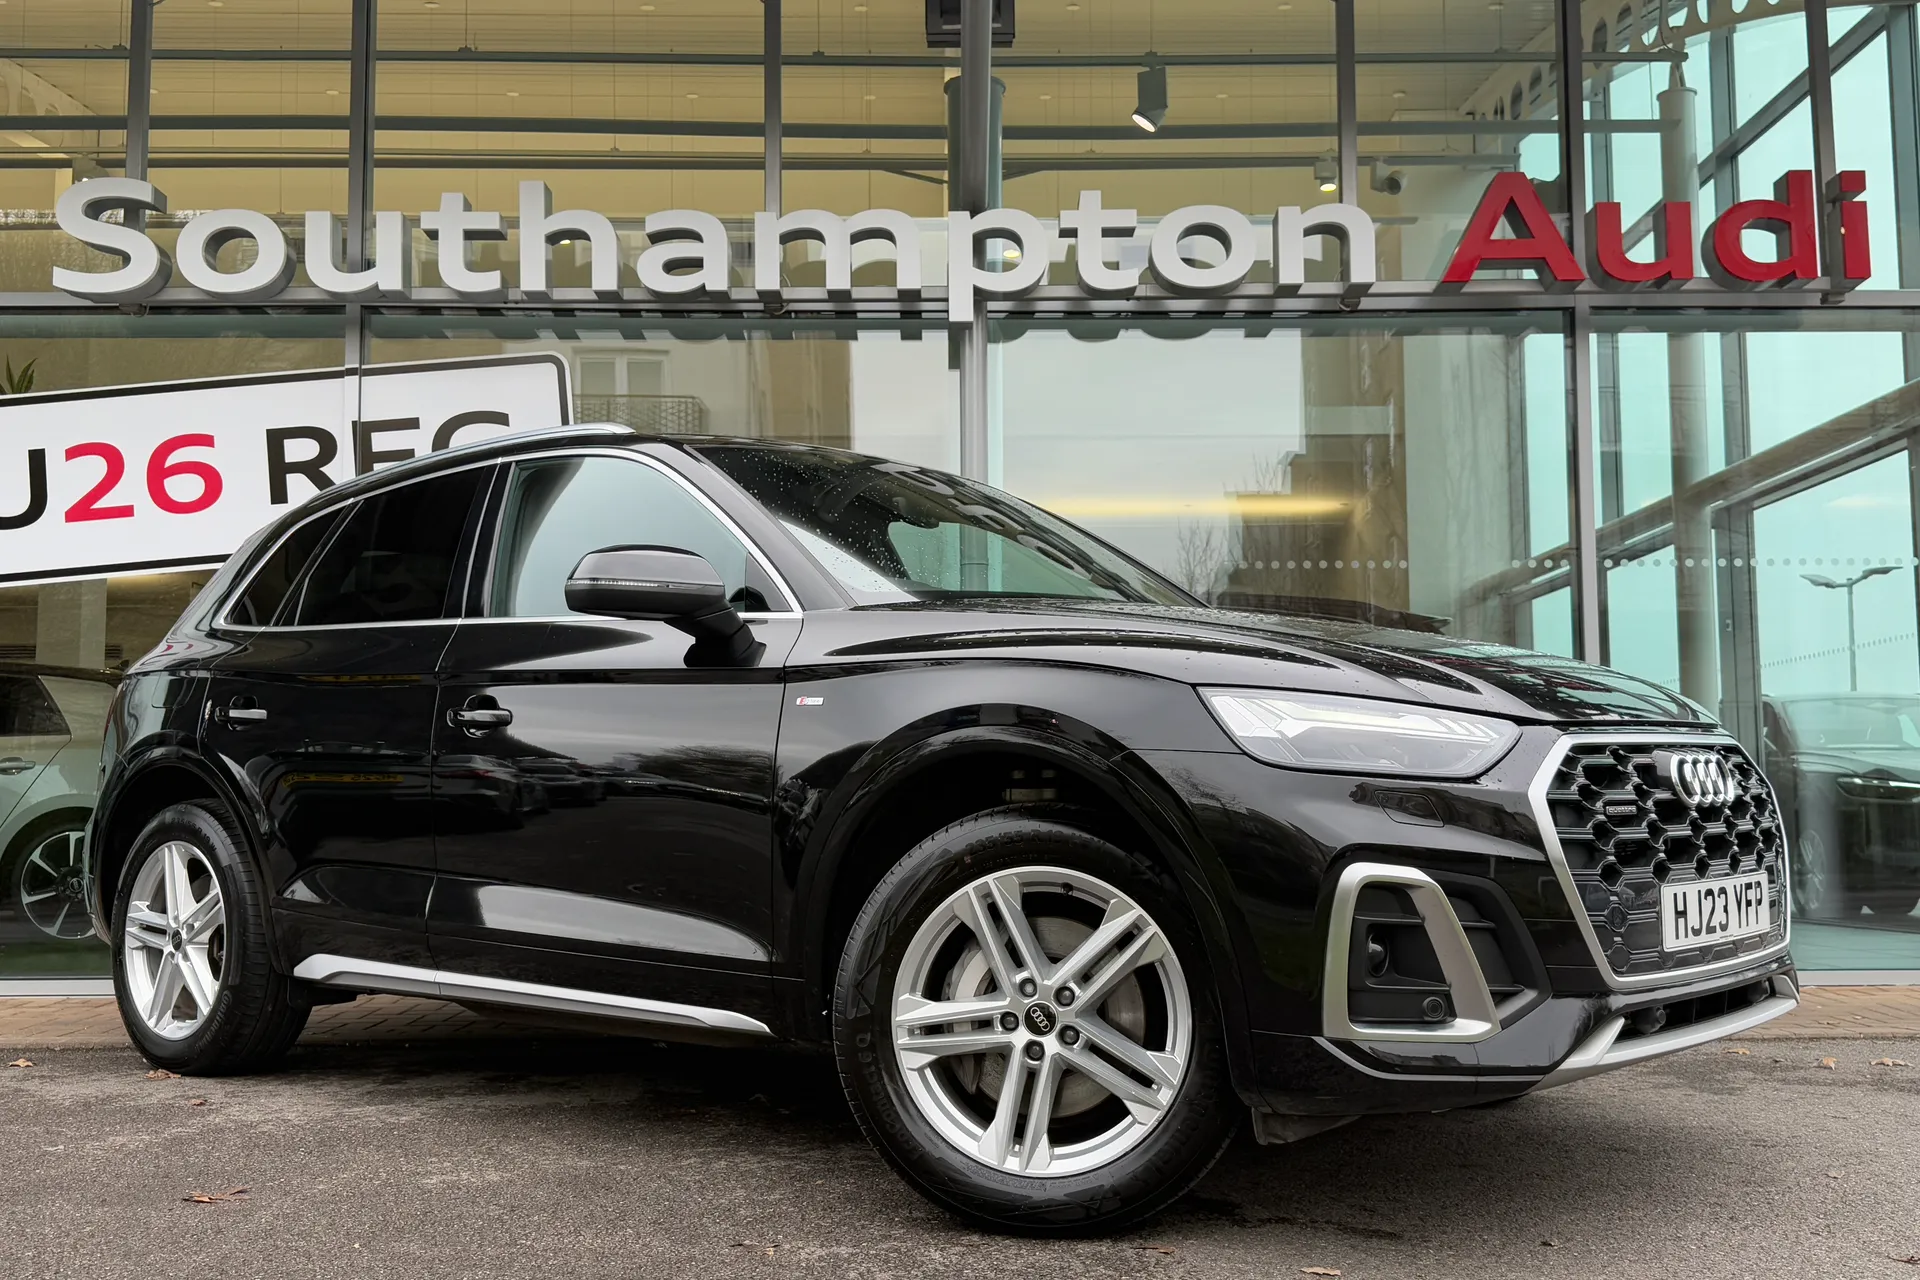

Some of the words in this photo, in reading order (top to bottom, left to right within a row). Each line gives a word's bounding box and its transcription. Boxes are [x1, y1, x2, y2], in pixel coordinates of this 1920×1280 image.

[52, 176, 1377, 323] Southampton
[1440, 169, 1872, 288] Audi
[1673, 886, 1729, 940] HJ23
[1733, 880, 1763, 929] YFP
